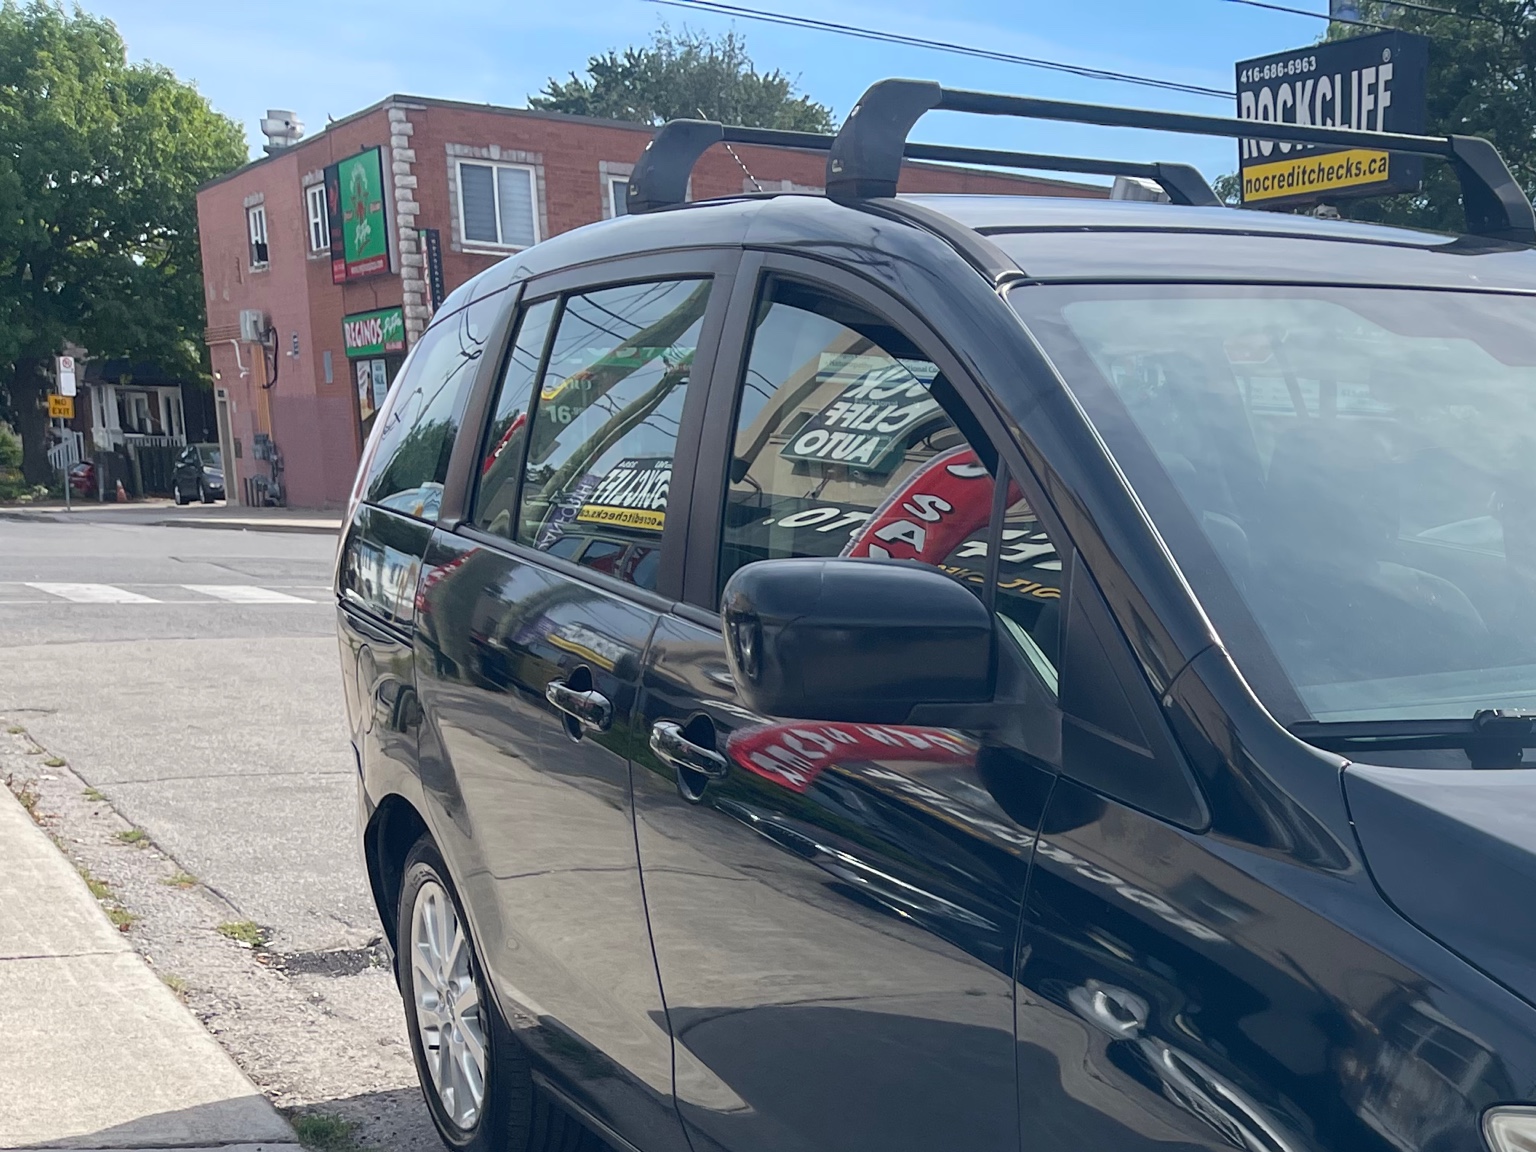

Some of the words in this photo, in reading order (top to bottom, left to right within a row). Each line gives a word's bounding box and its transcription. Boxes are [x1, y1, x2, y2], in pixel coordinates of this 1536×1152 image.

[1240, 56, 1317, 84] 416-686-6963
[1241, 62, 1394, 159] ROCKCLIFF
[1245, 154, 1388, 195] nocreditchecks.ca
[344, 318, 383, 348] REGINOS
[52, 407, 70, 416] EXIT
[54, 398, 67, 406] NO
